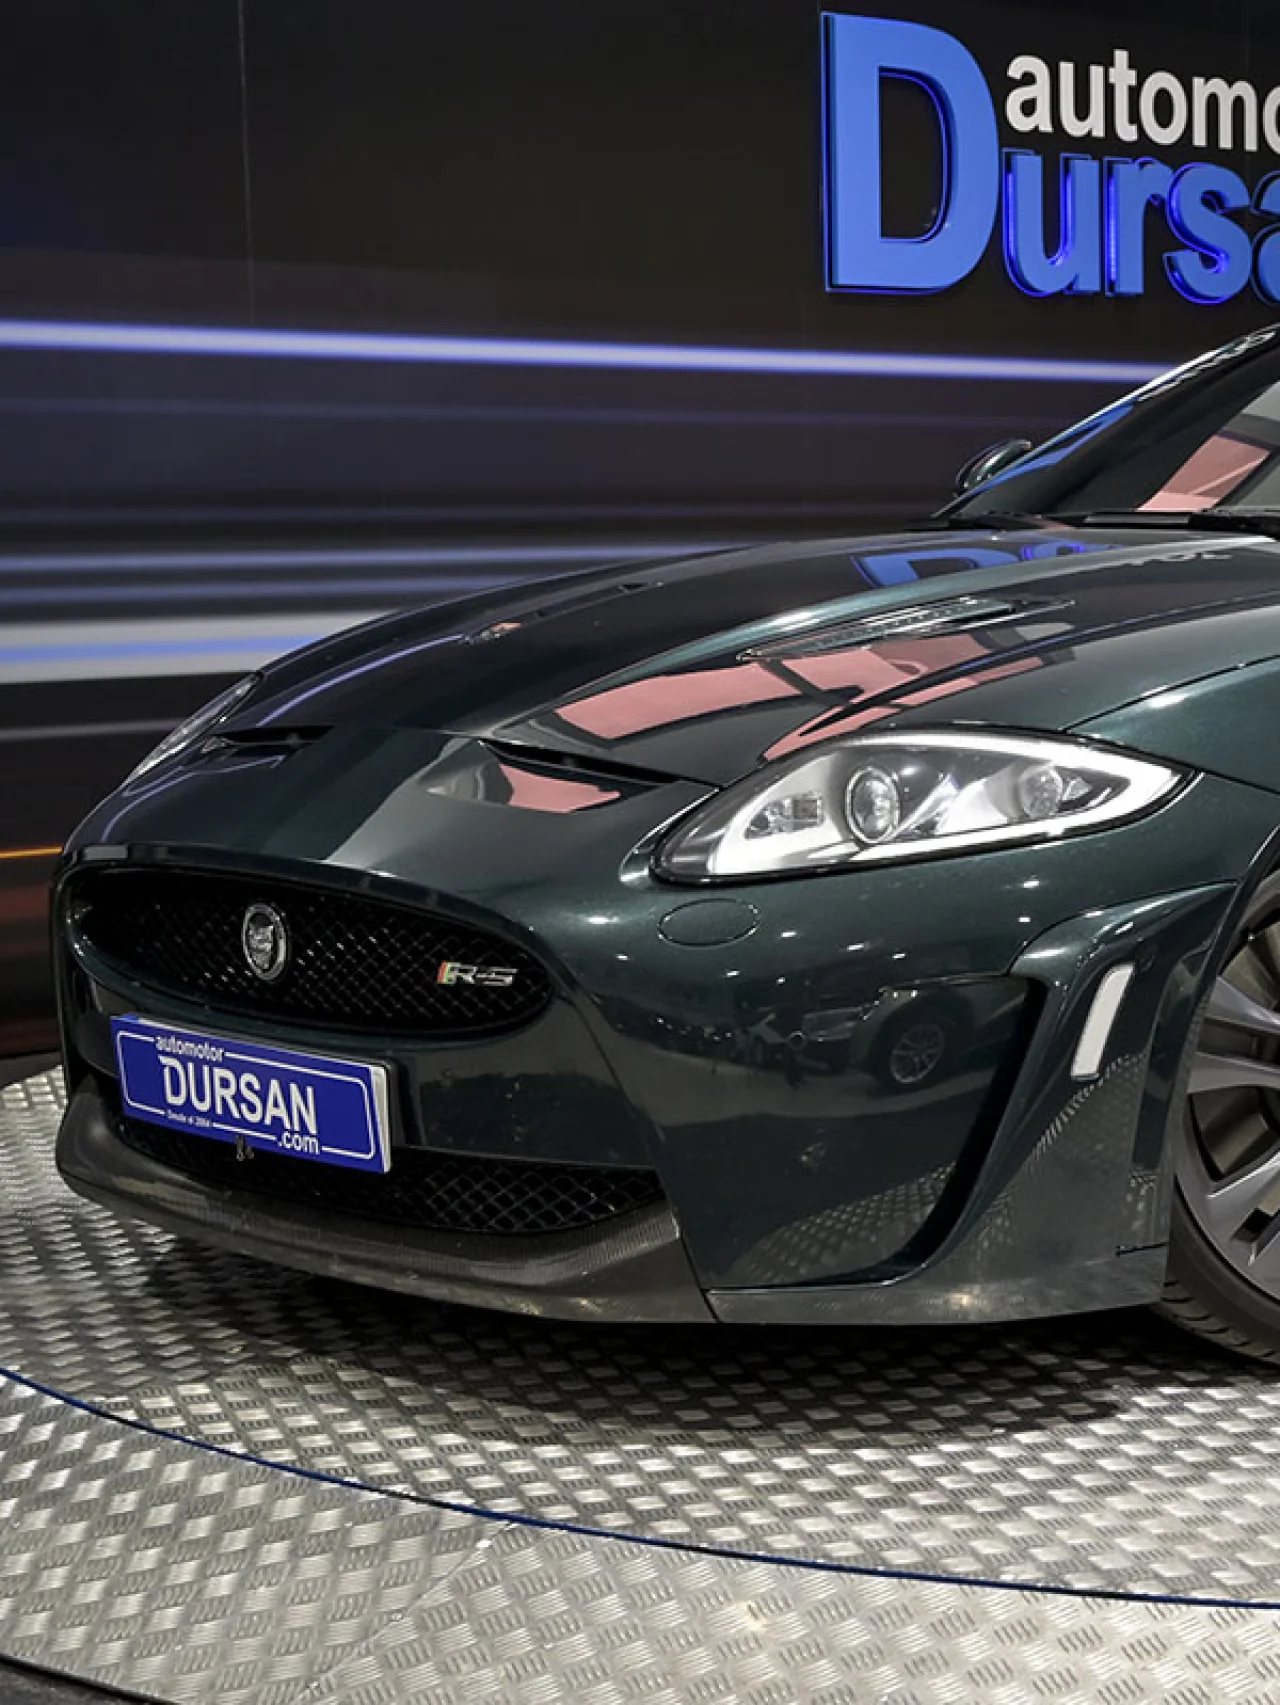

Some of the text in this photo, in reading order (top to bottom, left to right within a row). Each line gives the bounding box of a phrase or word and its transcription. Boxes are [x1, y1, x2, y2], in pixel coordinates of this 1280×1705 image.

[156, 1035, 224, 1062] automotor
[158, 1055, 317, 1134] DURSAN
[277, 1131, 320, 1155] .com
